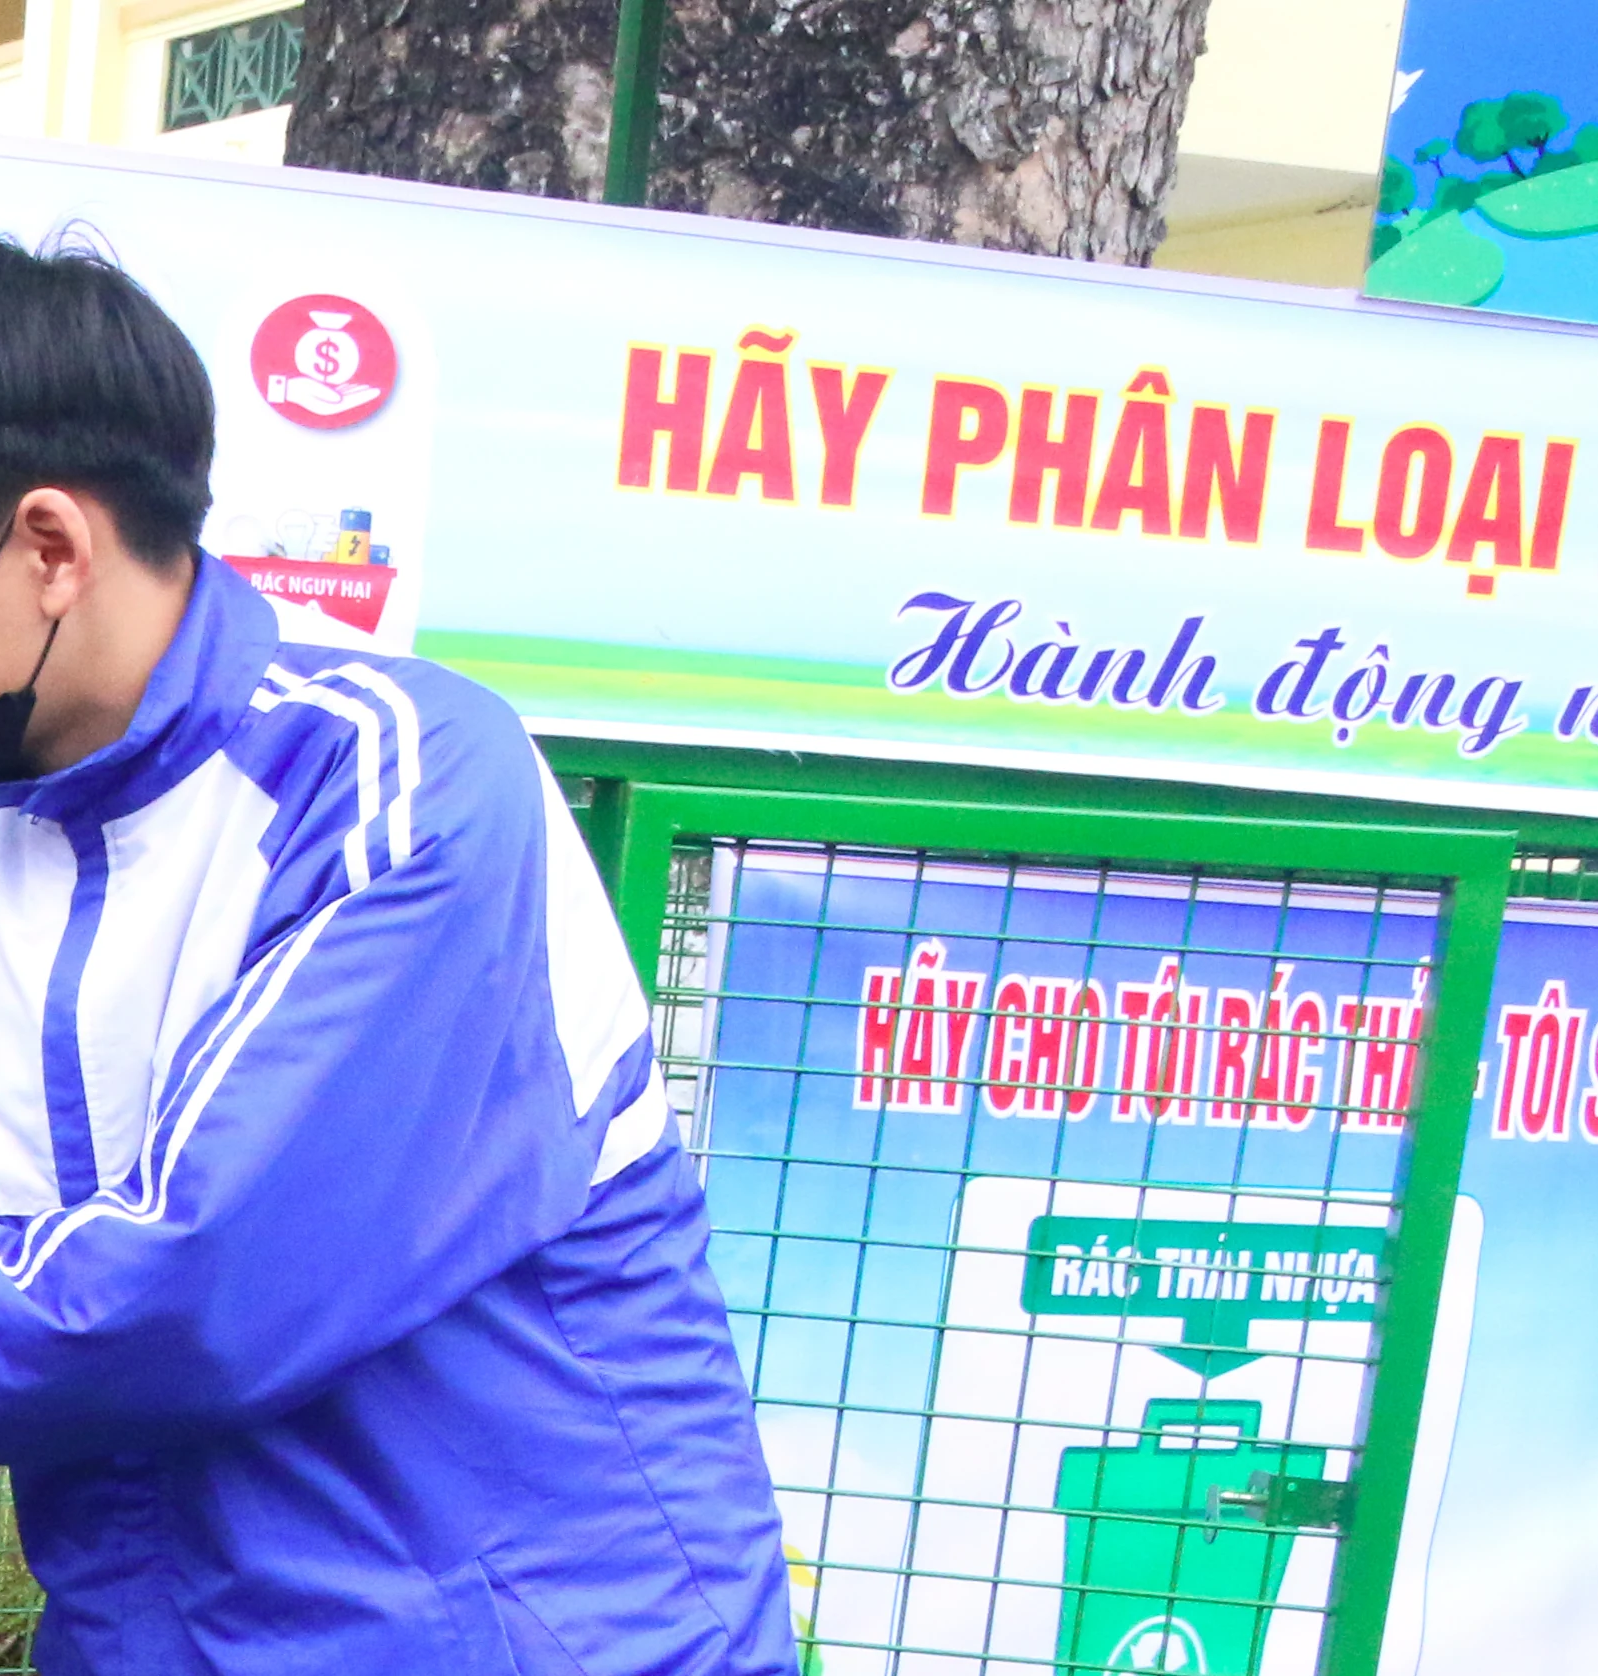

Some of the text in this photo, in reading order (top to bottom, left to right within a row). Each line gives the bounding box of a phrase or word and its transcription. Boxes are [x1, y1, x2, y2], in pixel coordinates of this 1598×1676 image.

[617, 326, 1578, 598] HÃY PHÂN LOẠI
[251, 572, 372, 603] RÁC NGUY HẠI
[891, 591, 1222, 711] Hành
[1255, 626, 1526, 753] động
[853, 938, 985, 1114] HÃY
[980, 974, 1107, 1121] CHO
[1111, 957, 1209, 1125] TÔI
[1207, 963, 1326, 1130] RÁC
[1491, 980, 1589, 1142] TÔI
[1051, 1235, 1141, 1298] RÁC
[1260, 1248, 1376, 1314] NHỰA
